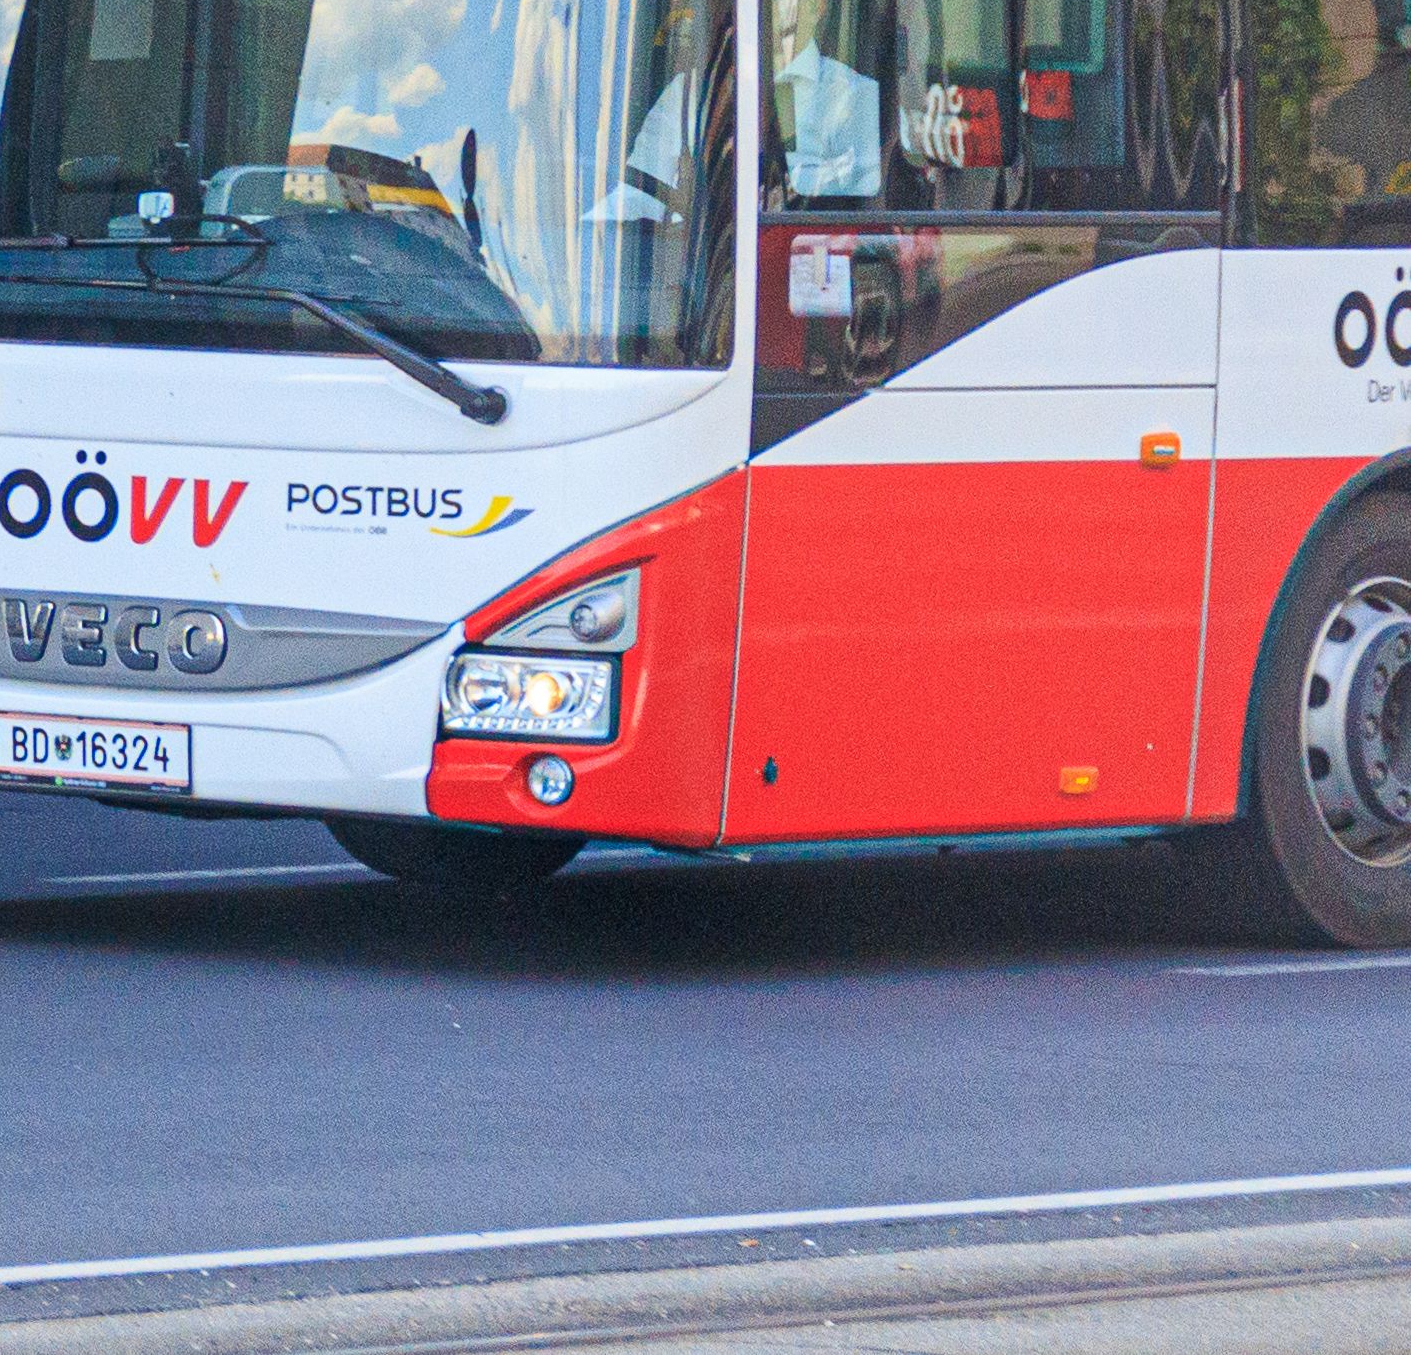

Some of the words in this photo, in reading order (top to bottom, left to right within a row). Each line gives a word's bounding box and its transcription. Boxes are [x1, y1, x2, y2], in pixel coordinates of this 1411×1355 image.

[1368, 378, 1396, 403] Der
[287, 482, 464, 520] POSTBUS
[12, 725, 49, 764] BD
[76, 730, 170, 773] 16324
